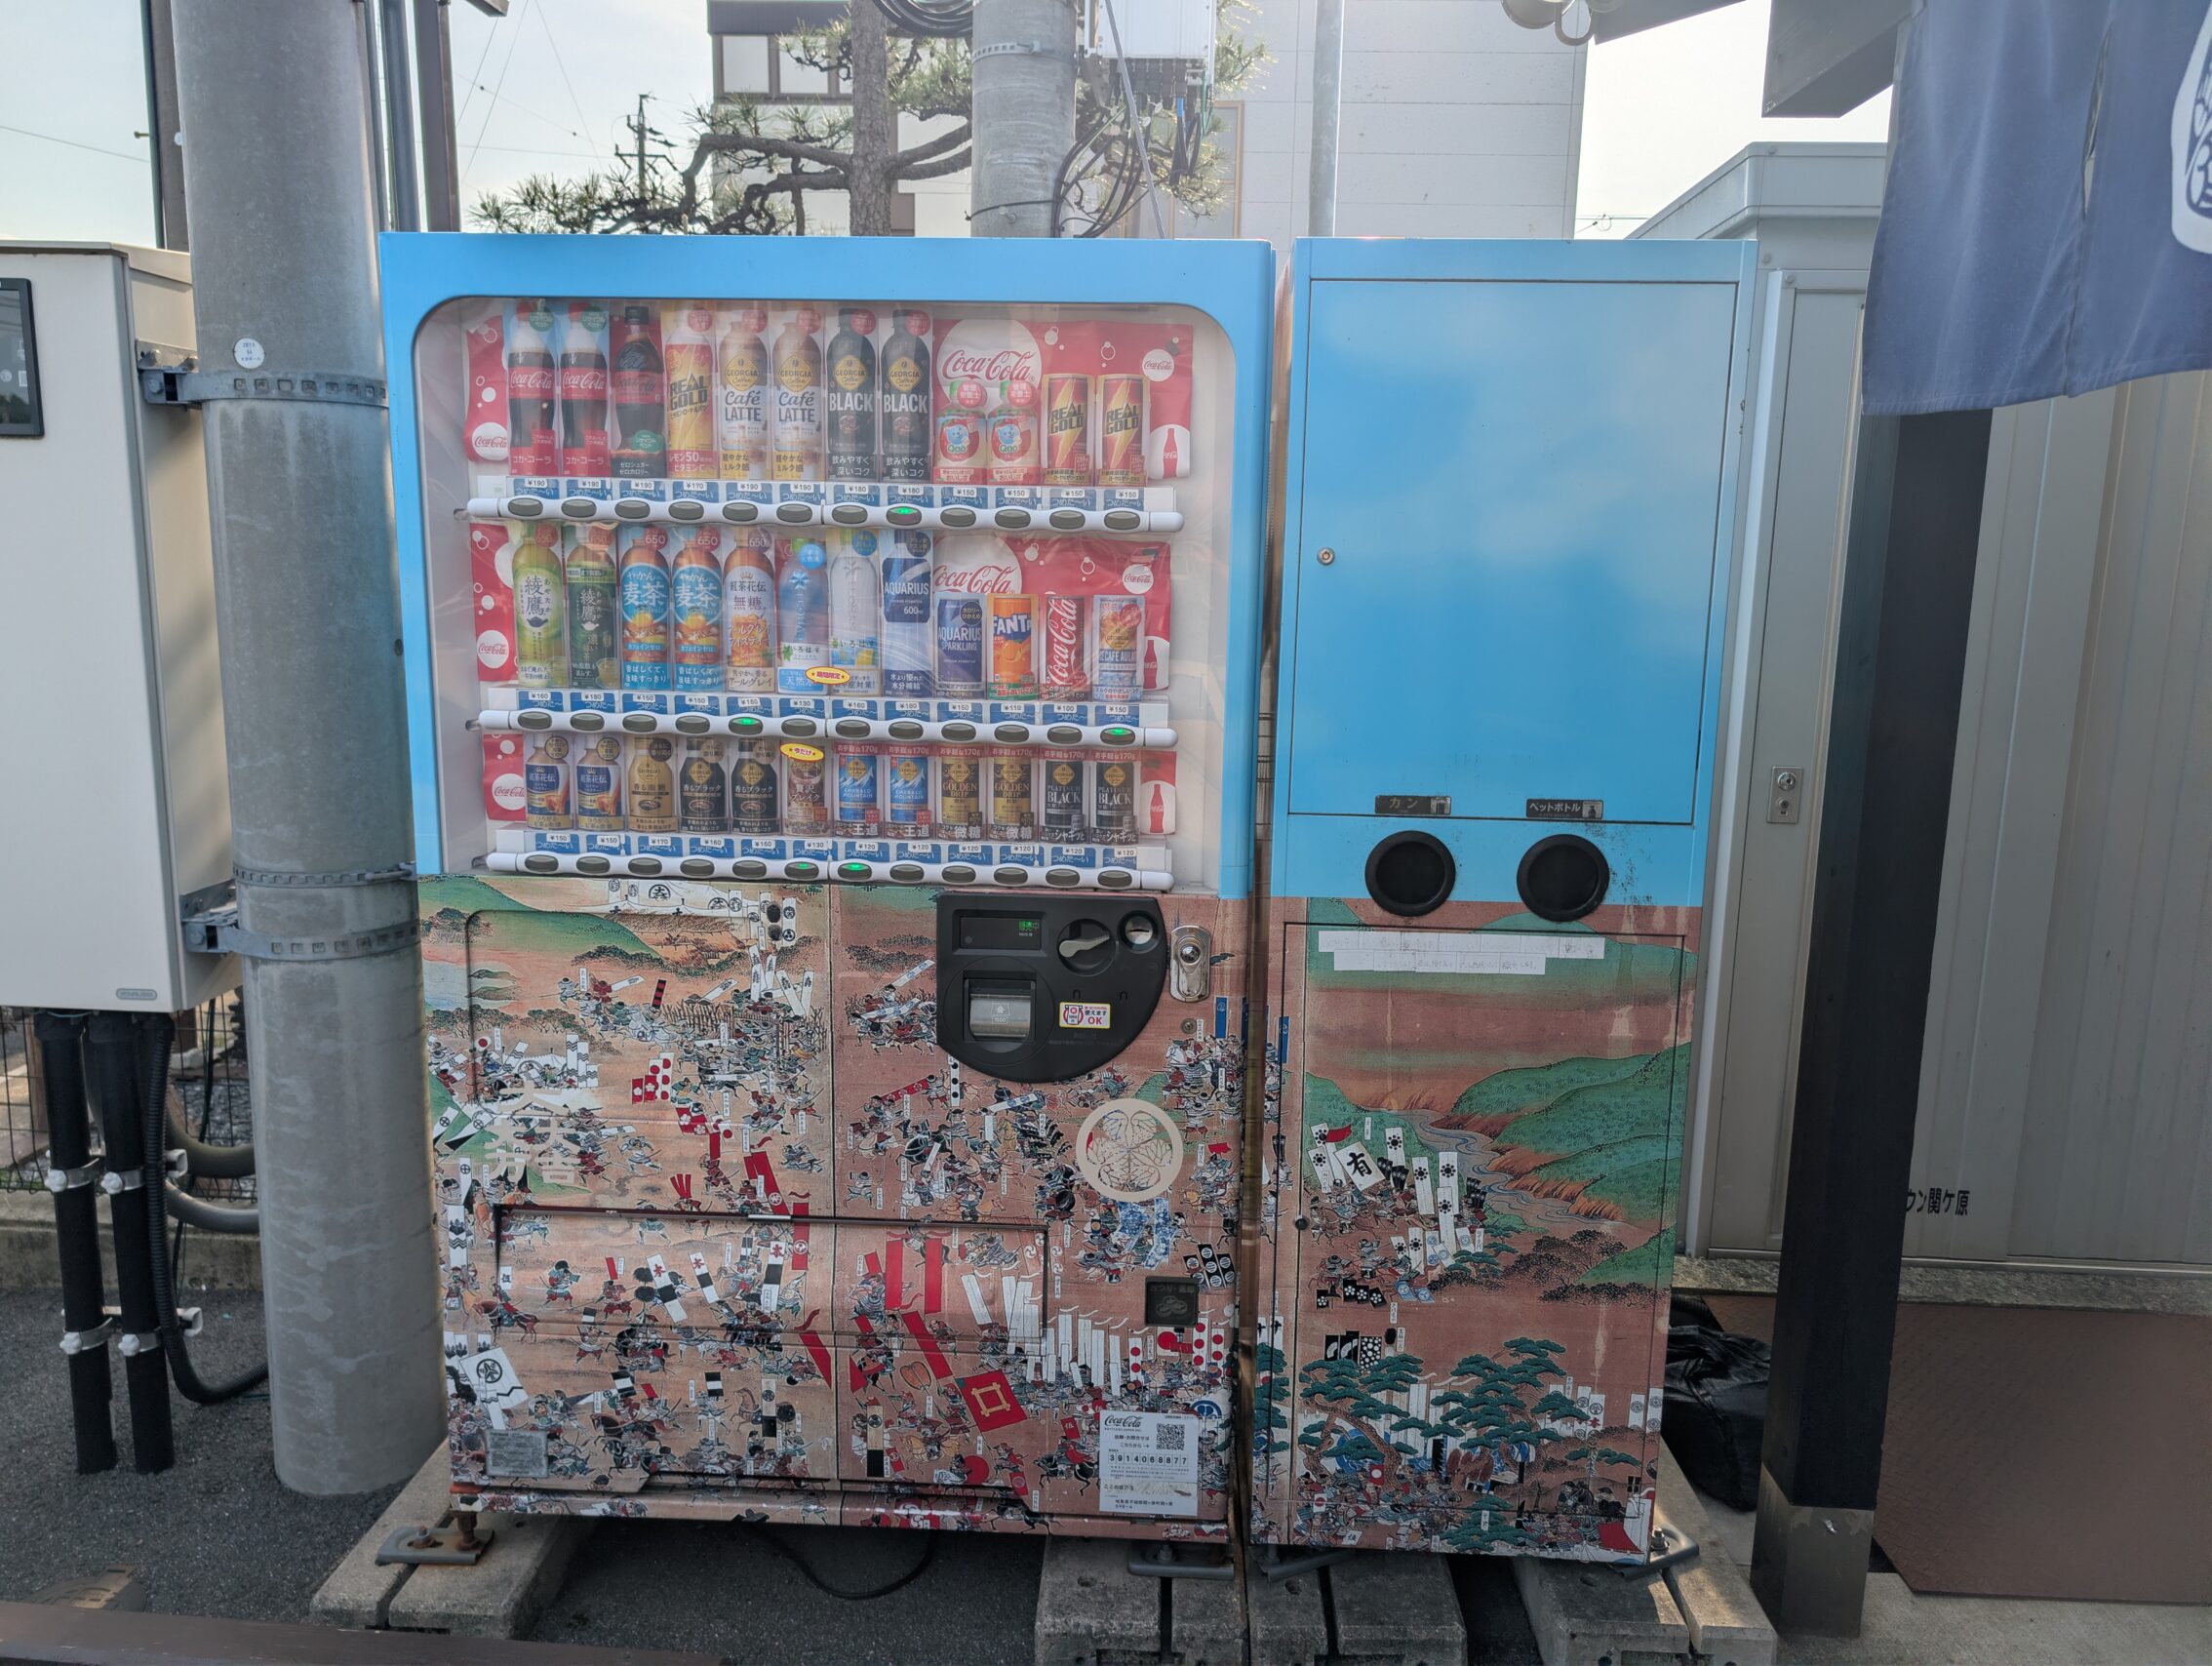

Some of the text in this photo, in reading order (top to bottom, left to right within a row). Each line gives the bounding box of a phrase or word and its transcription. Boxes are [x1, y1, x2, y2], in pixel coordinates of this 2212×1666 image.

[942, 350, 1037, 381] Coca-Cola
[1144, 360, 1173, 371] Coca-Cola
[727, 369, 758, 377] GEORGIA
[780, 370, 811, 378] GEORGIA
[510, 371, 553, 390] Coca-Cola
[563, 371, 604, 390] Coca-Cola
[670, 374, 709, 396] REAL
[671, 389, 708, 411] GOLD
[725, 390, 761, 407] Café
[778, 392, 814, 407] Café
[830, 393, 874, 412] BLACK
[884, 394, 928, 414] BLACK
[725, 407, 762, 421] LATTE
[778, 408, 815, 422] LATTE
[1051, 404, 1084, 420] REAL
[1106, 405, 1139, 421] REAL
[1051, 416, 1085, 433] GOLD
[1107, 417, 1140, 434] GOLD
[947, 445, 967, 454] Qoo
[999, 445, 1018, 454] Qoo
[512, 456, 552, 464] コカ・コーラ
[566, 456, 605, 465] コカ・コーラ
[832, 456, 869, 465] 飲みやすく
[886, 456, 925, 466] 飲みやすく
[837, 467, 870, 477] 深いコク
[890, 468, 924, 478] 深いコク
[646, 536, 665, 544] 650
[697, 537, 718, 546] 650
[749, 538, 766, 547] 650
[1124, 573, 1153, 583] Coca-Cola
[731, 581, 767, 592] 紅茶花伝
[884, 582, 928, 594] AQUARIUS
[525, 577, 545, 615] 綾鷹
[623, 582, 667, 607] 麦茶
[676, 583, 720, 608] 麦茶
[580, 589, 596, 621] 綾鷹
[733, 597, 764, 611] 無糖
[938, 627, 981, 641] AQUARIUS
[942, 642, 977, 652] SPARKLING
[1047, 598, 1078, 687] Coca-Cola
[479, 643, 507, 655] Coca-Cola
[816, 671, 842, 680] 期間限定
[891, 682, 921, 691] 水分補給
[794, 747, 812, 756] 今だけ
[795, 784, 815, 794] 贅沢
[791, 793, 820, 803] ブレイク
[1047, 791, 1081, 803] BLACK
[1098, 793, 1131, 805] BLACK
[1388, 797, 1419, 809] カン
[1529, 802, 1581, 813] ペットボトル
[852, 823, 878, 836] 王道
[904, 824, 929, 837] 王道
[955, 826, 981, 839] 微糖
[1006, 826, 1032, 839] 微糖
[1054, 830, 1085, 842] シャキッと
[1105, 831, 1136, 842] シャキッと
[1346, 1152, 1373, 1177] 有
[1104, 1414, 1143, 1428] Coca-Cola
